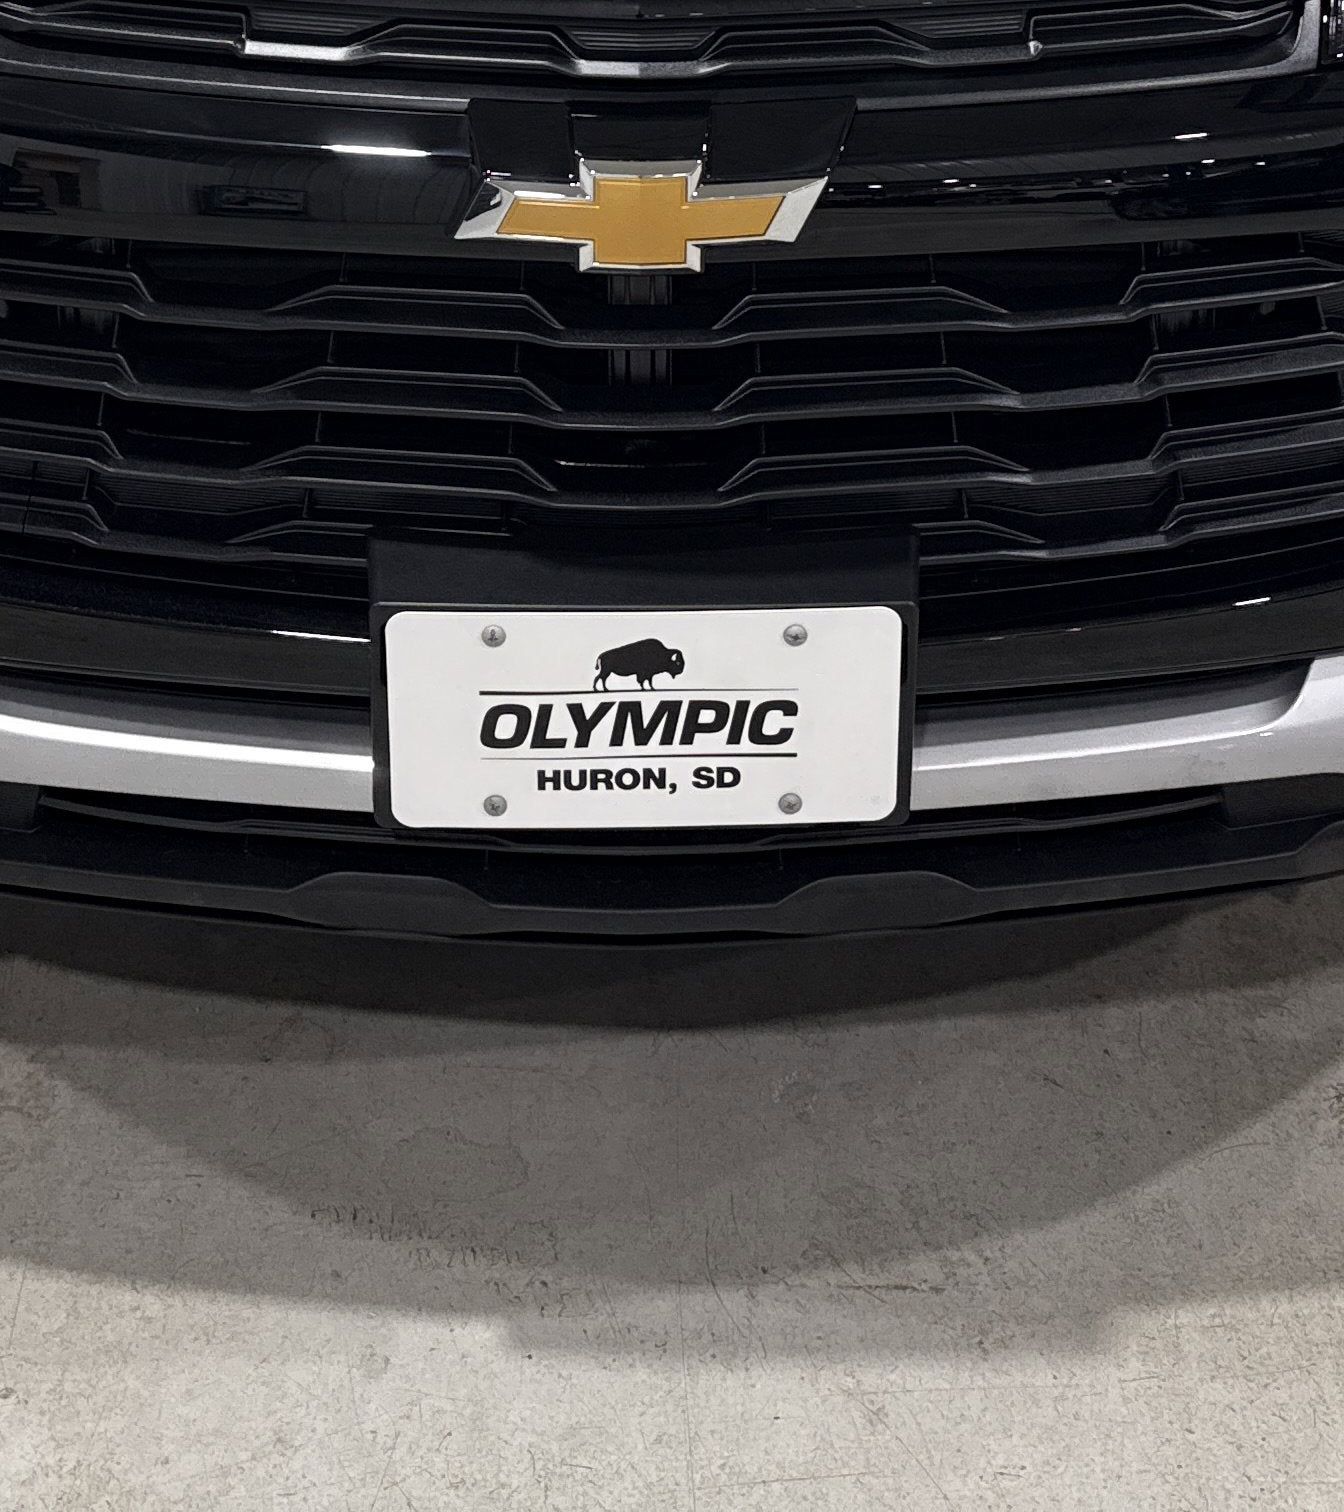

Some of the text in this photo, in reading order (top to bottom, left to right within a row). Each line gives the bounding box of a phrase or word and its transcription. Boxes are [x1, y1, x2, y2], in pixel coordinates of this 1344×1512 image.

[479, 699, 798, 749] OLYMPIC
[537, 767, 741, 793] HURON, SD
